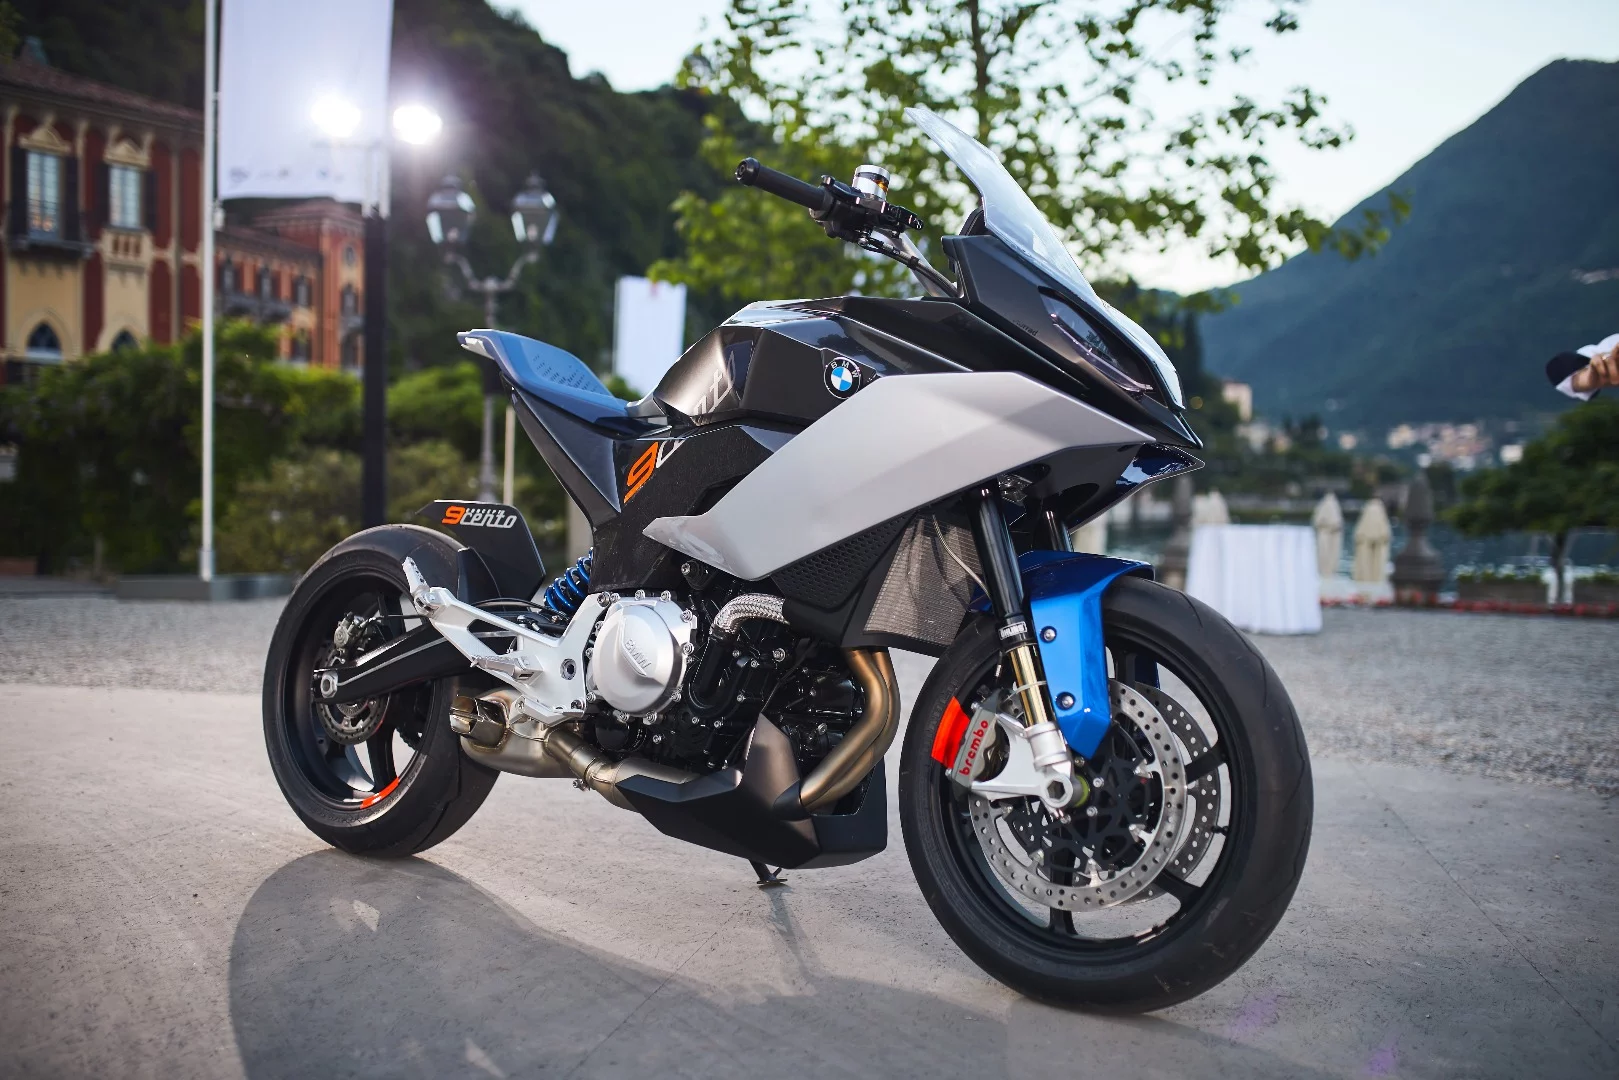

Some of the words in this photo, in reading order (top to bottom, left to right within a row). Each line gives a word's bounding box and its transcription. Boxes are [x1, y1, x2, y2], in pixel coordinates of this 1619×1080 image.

[830, 360, 859, 378] BMW
[441, 505, 518, 529] 9cento
[625, 639, 652, 669] BMW
[959, 720, 989, 776] brembo
